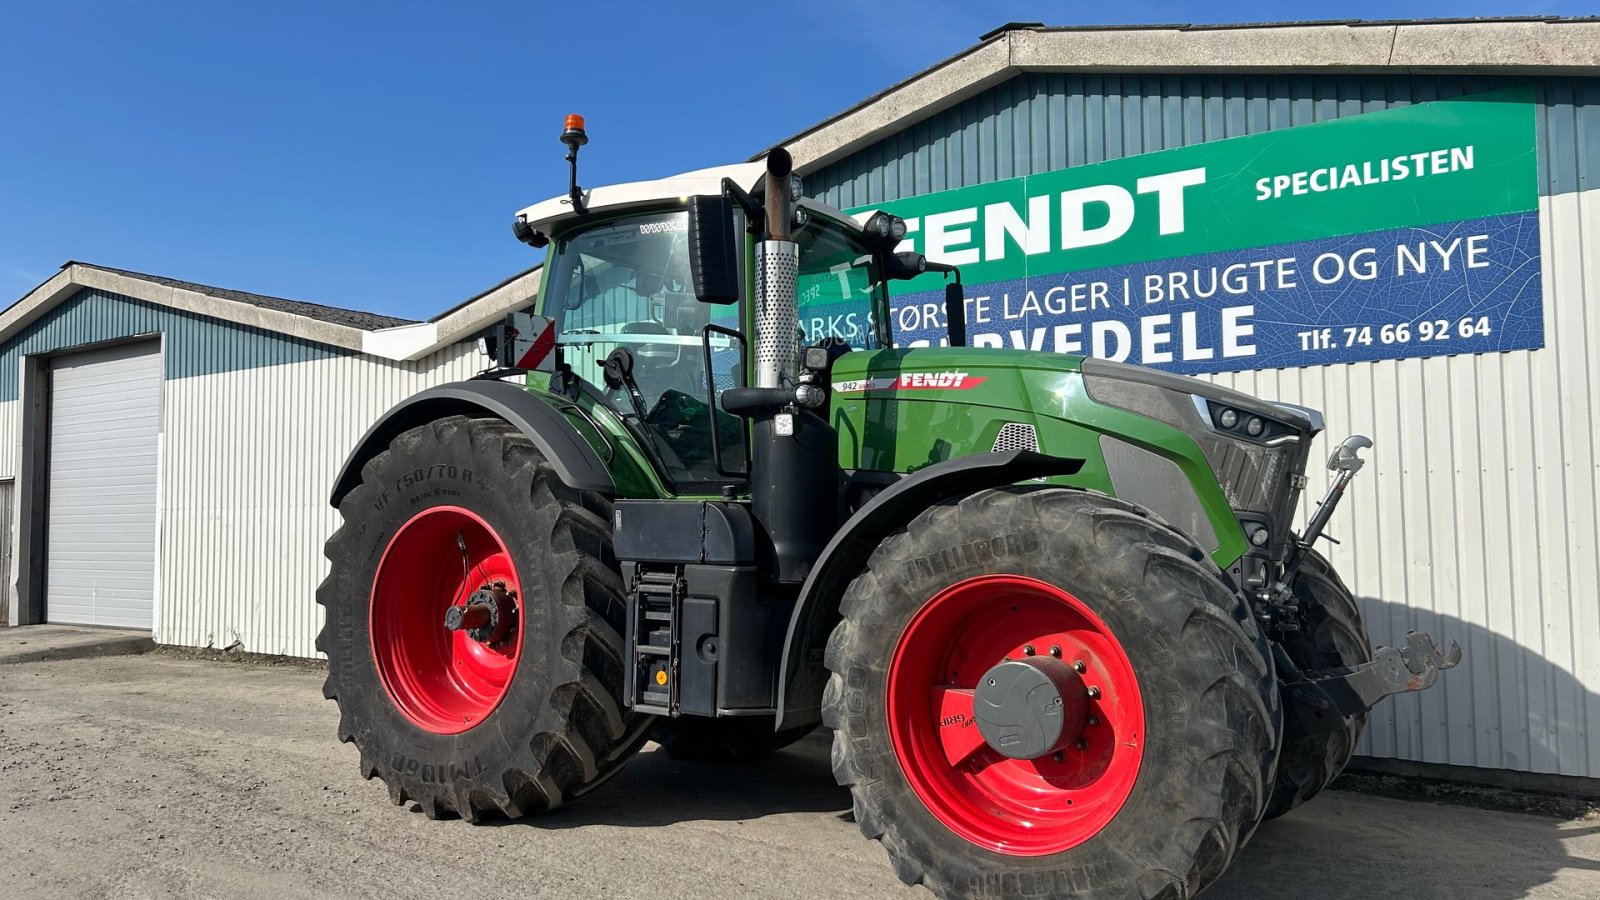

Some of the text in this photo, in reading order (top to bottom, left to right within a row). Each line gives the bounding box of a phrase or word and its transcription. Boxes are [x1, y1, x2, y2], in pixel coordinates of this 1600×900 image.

[1255, 145, 1474, 201] SPECIALISTEN
[1003, 281, 1111, 320] LAGER
[1123, 278, 1130, 306] I
[1144, 257, 1297, 304] BRUGTE
[1312, 247, 1377, 285] OG
[1397, 234, 1490, 277] NYE
[1298, 315, 1491, 351] Tlf. 74 66 92 64
[842, 382, 857, 391] 942
[901, 370, 968, 387] FENDT
[394, 463, 458, 494] 750/70
[461, 469, 473, 483] R
